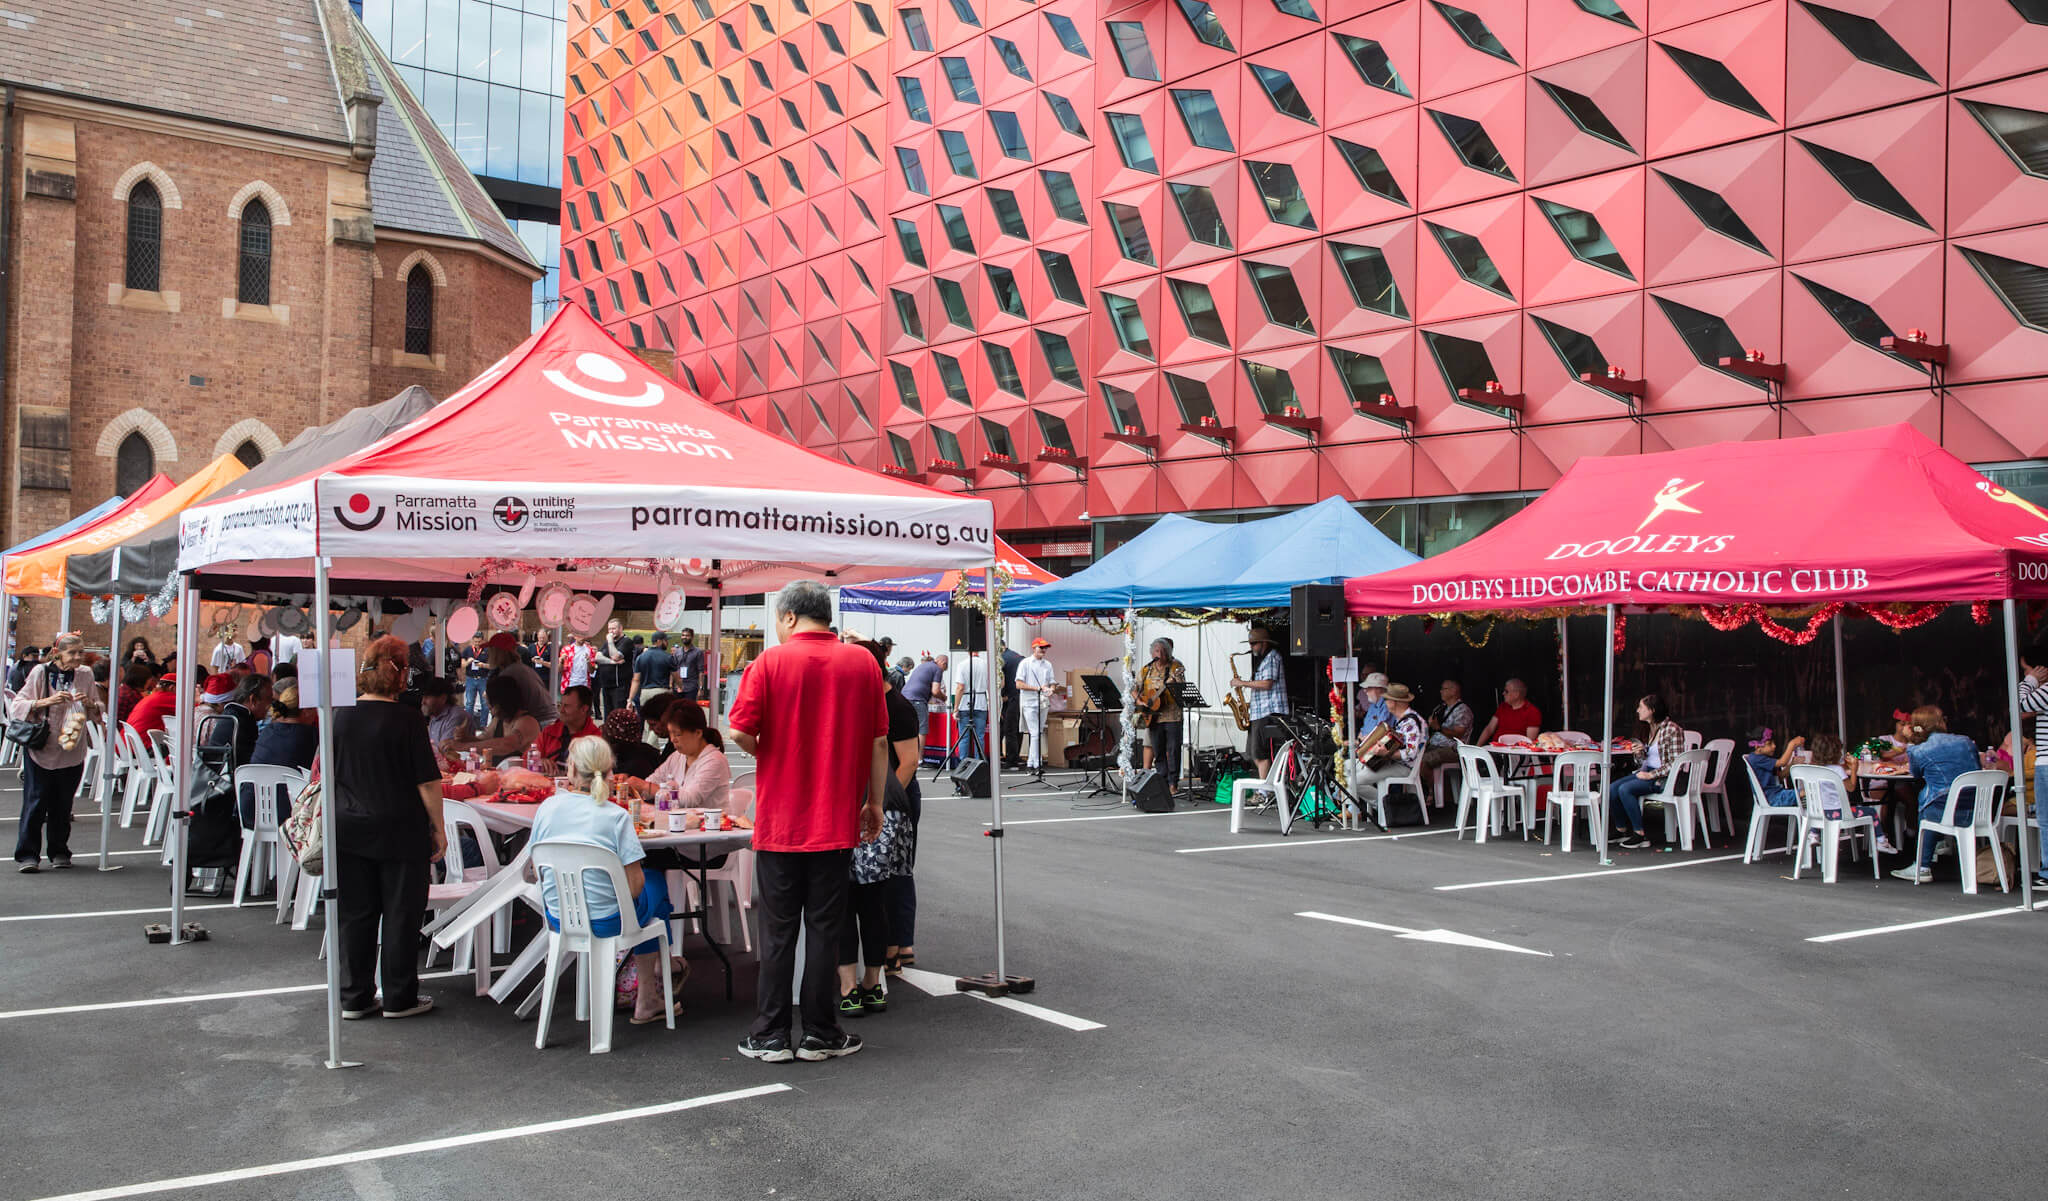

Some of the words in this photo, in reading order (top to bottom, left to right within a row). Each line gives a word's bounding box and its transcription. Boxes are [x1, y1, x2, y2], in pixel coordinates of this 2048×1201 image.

[549, 411, 716, 440] Parramatta
[560, 429, 735, 461] Mission
[395, 494, 477, 508] Parramatta
[533, 496, 575, 509] uniting
[533, 508, 573, 519] church
[396, 511, 478, 531] Mission
[631, 505, 989, 546] parramattamission.org.au
[1544, 534, 1735, 560] DOOLEYS
[1412, 578, 1504, 604] DOOLEYS
[1510, 570, 1632, 598] LIDCOMBE
[1637, 570, 1783, 594] CATHOLIC
[1791, 568, 1869, 594] CLUB
